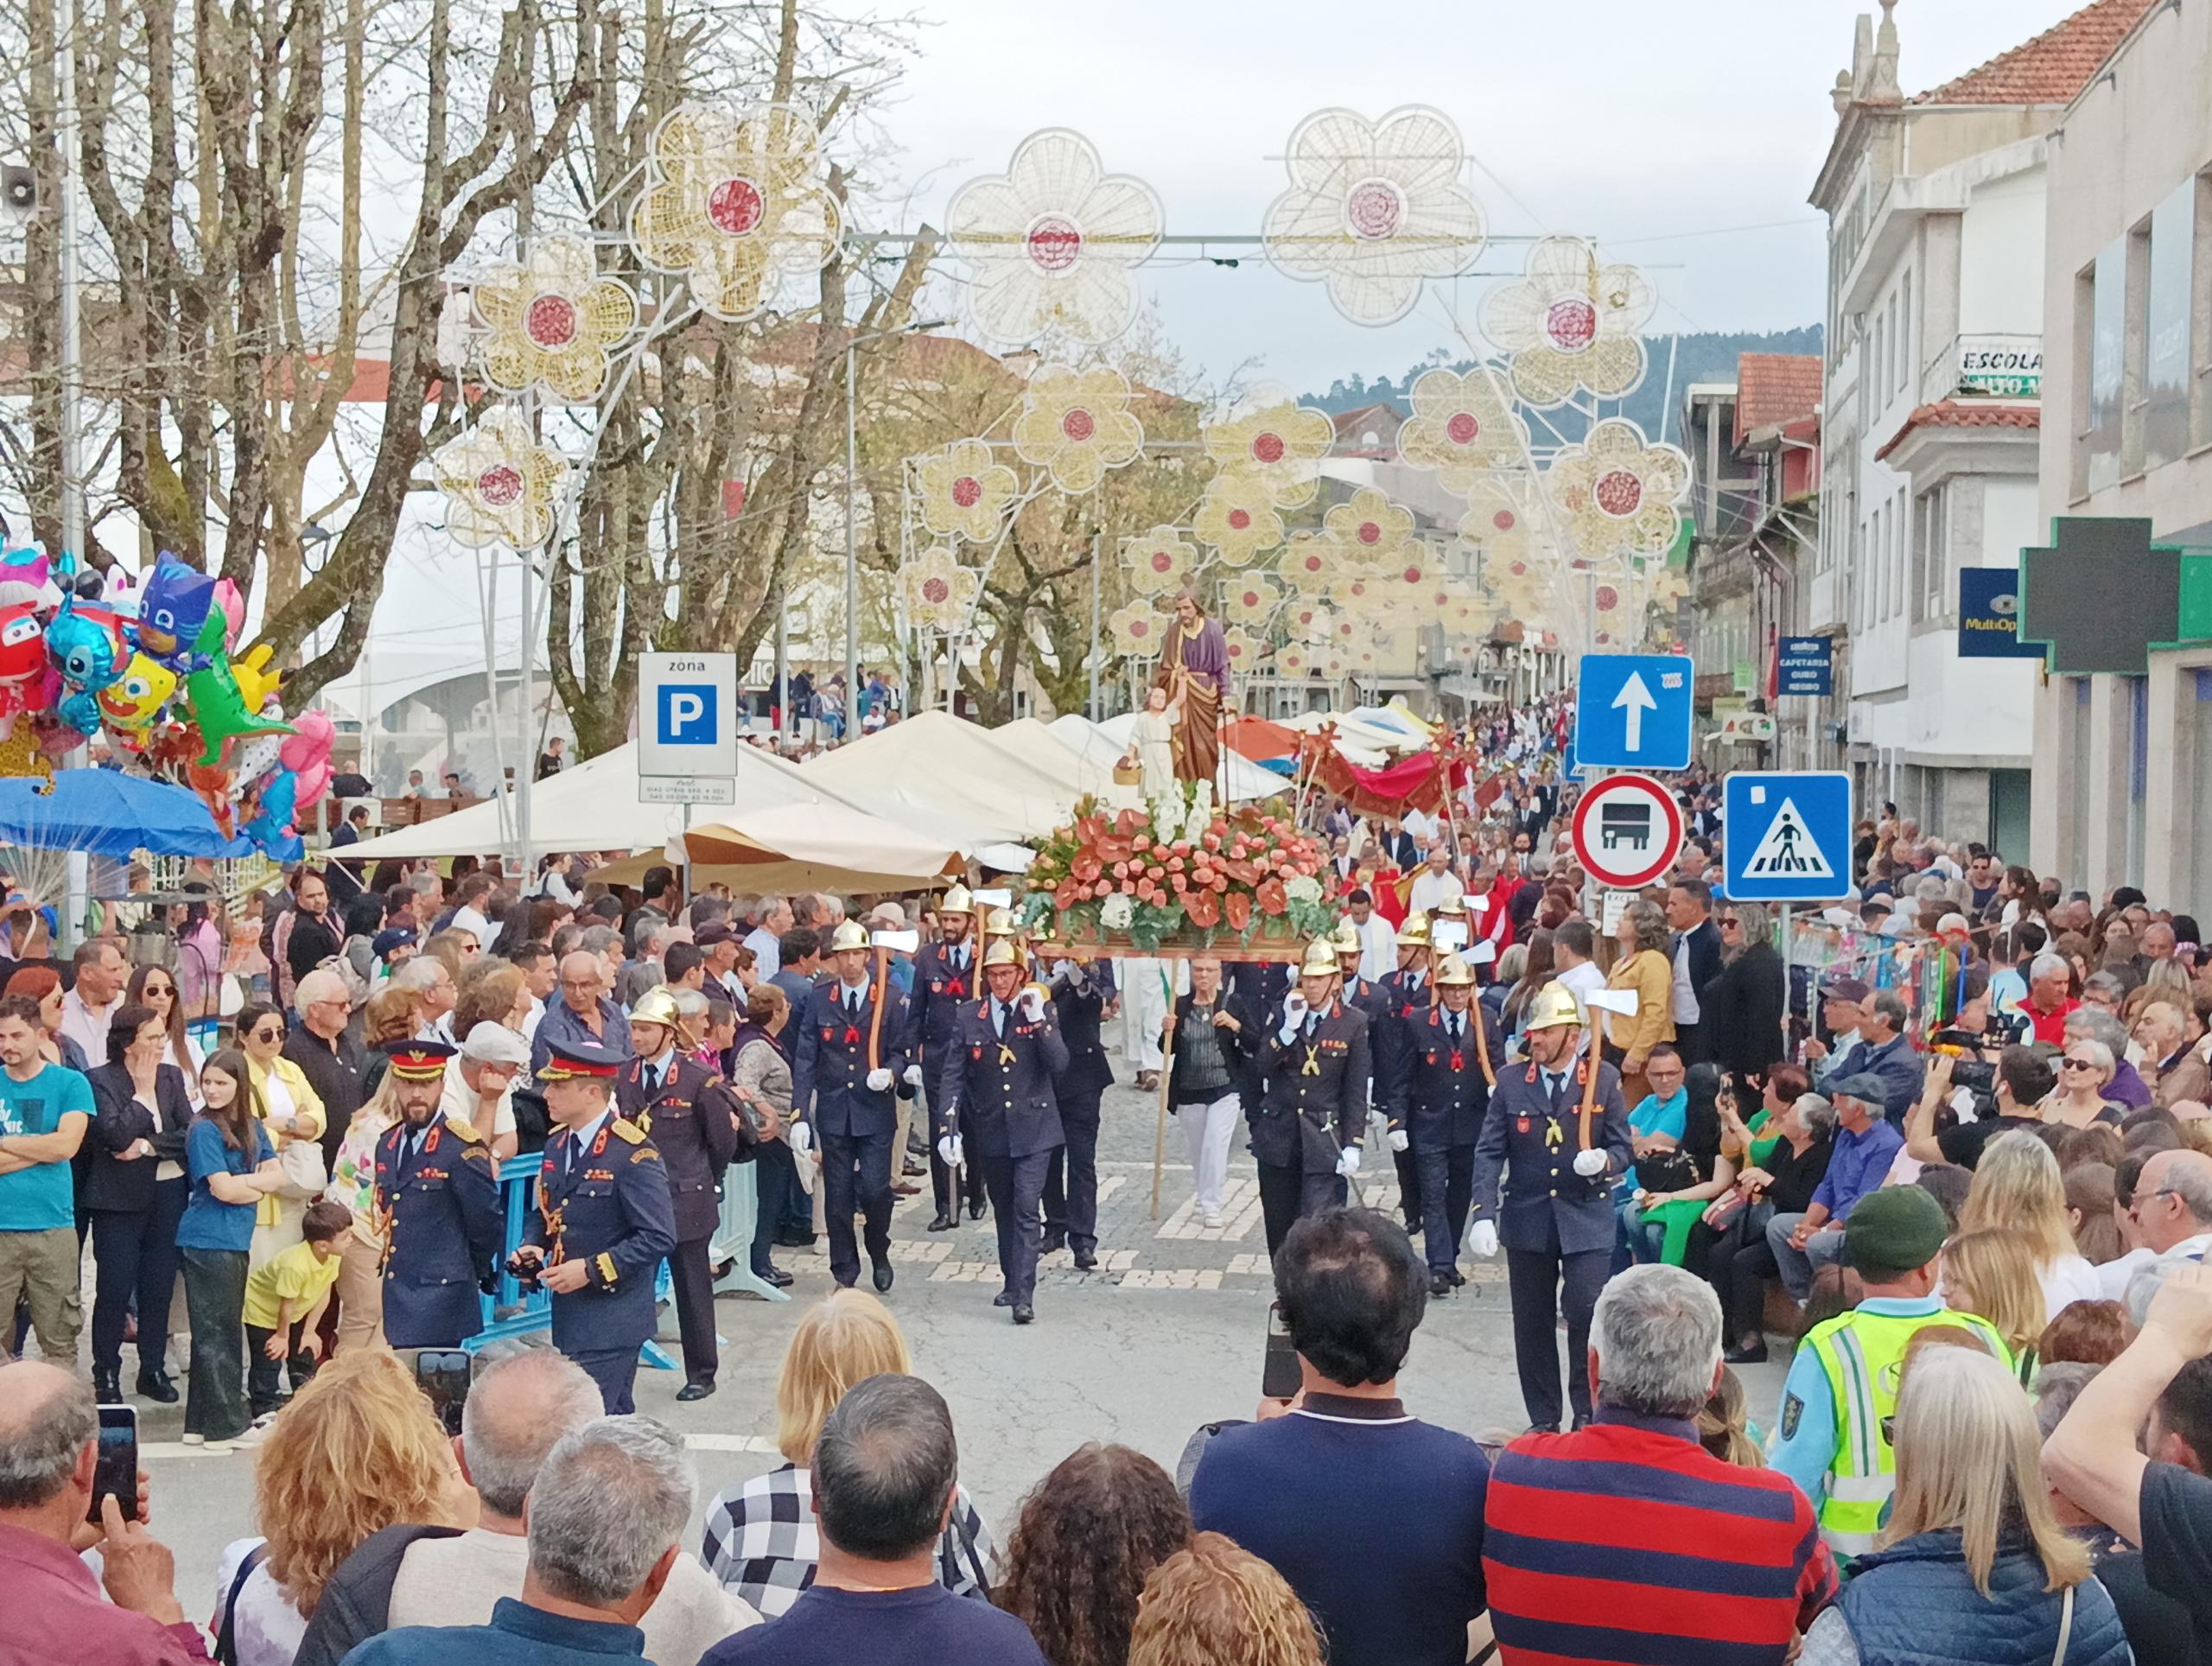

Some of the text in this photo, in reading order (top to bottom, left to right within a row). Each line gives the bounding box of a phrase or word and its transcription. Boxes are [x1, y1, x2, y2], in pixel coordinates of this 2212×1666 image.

[1963, 353, 2042, 370] ESCOLA
[1966, 618, 2017, 633] MultiOp
[669, 661, 705, 671] zona
[1780, 658, 1829, 667] CAFETARIA
[671, 693, 704, 736] P
